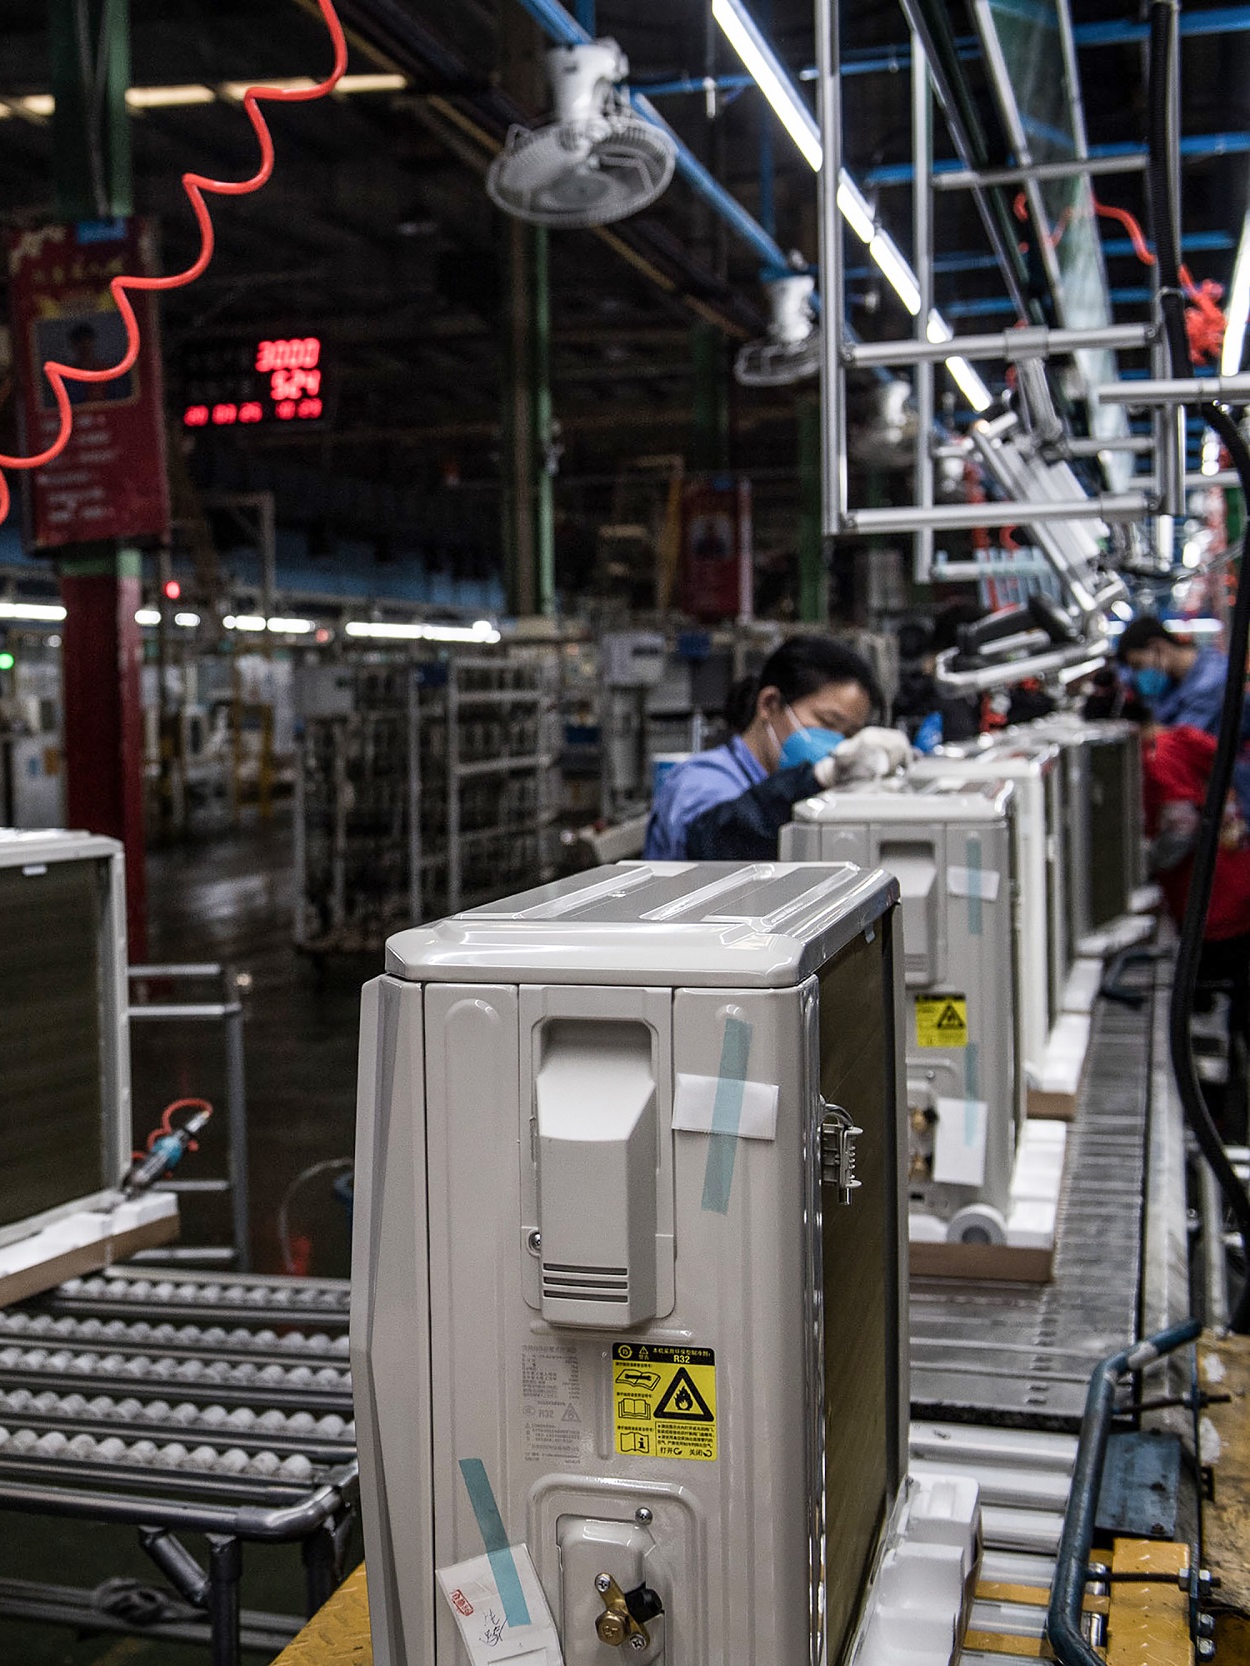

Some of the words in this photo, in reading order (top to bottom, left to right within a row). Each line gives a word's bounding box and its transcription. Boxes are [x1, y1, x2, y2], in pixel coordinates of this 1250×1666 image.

[673, 1355, 691, 1364] R32
[660, 1447, 673, 1455] 打开
[689, 1449, 703, 1457] 关闭
